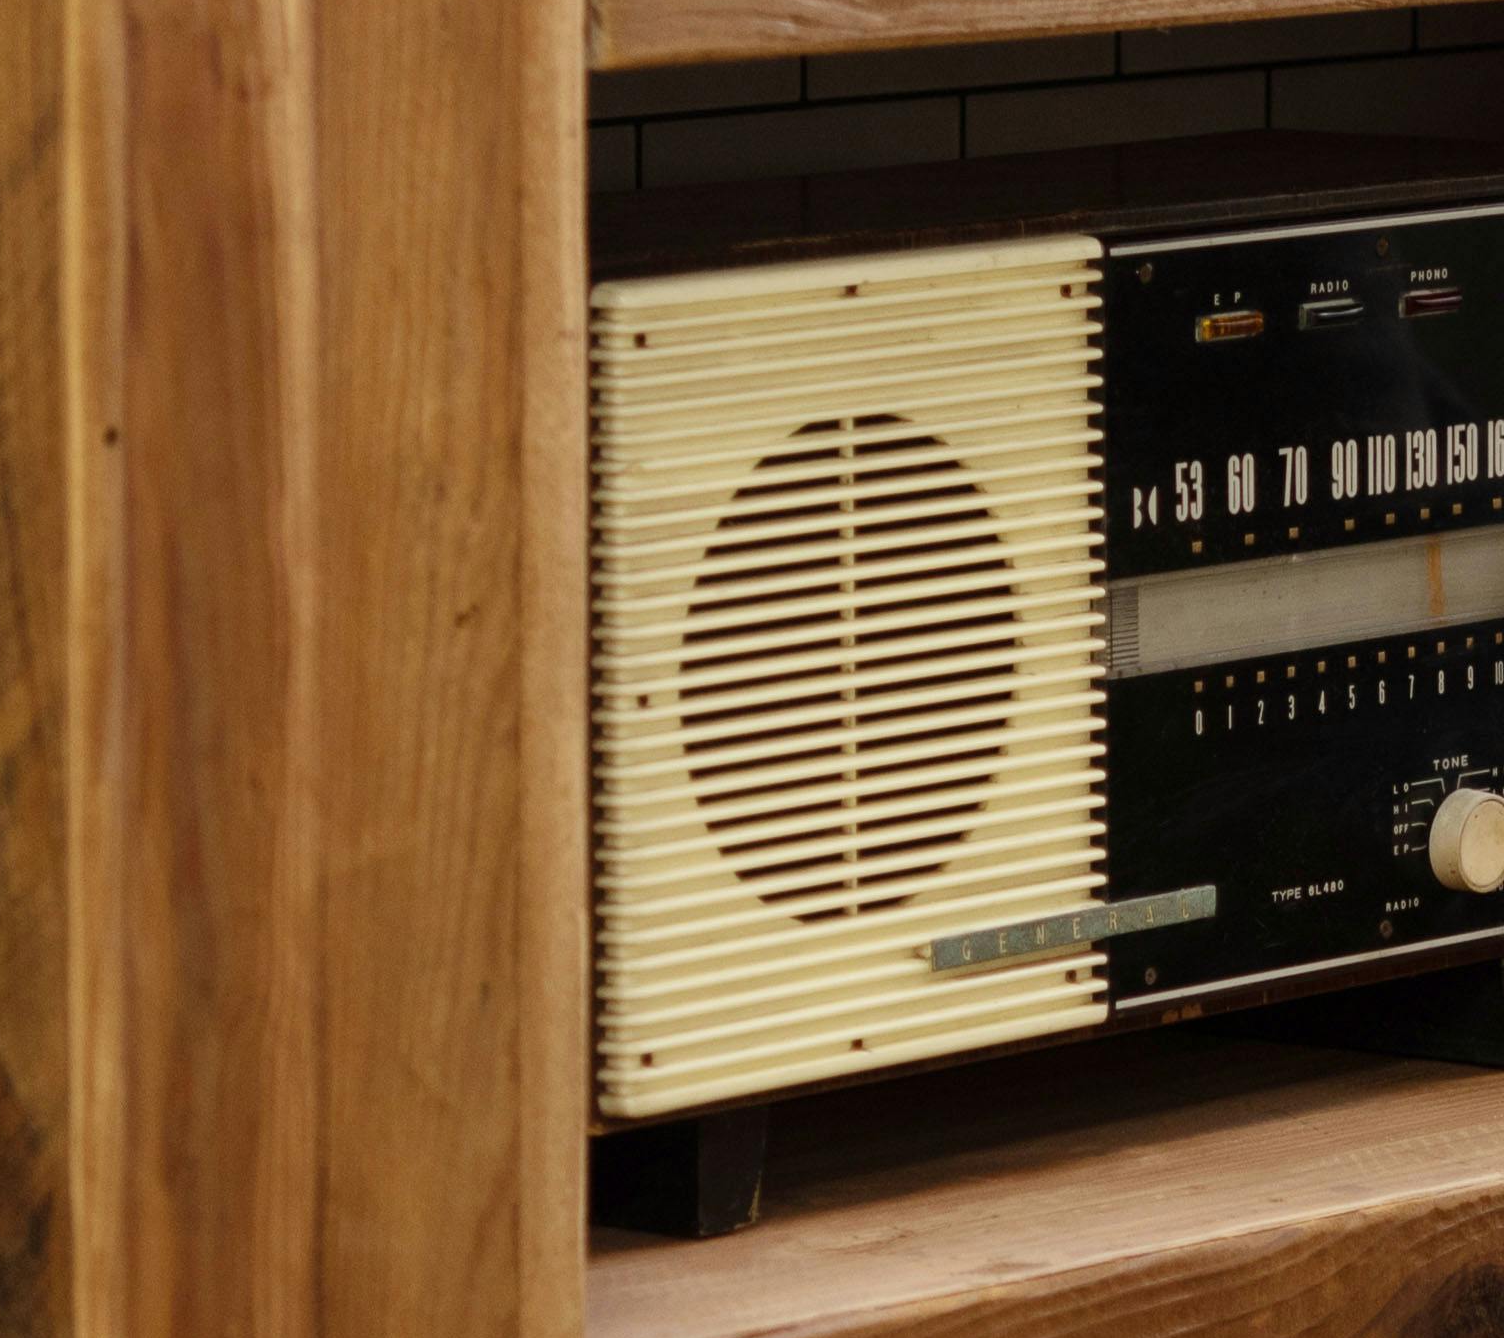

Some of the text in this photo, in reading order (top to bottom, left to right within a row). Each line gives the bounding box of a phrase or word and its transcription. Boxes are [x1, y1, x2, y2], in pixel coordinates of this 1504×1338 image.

[1410, 267, 1449, 282] PHONO
[1310, 279, 1350, 294] RADIO
[1175, 460, 1203, 522] 53
[1227, 452, 1255, 515] 60
[1278, 445, 1308, 508] 70
[1331, 438, 1358, 500] 90
[1367, 434, 1396, 496] 110
[1405, 428, 1438, 491] 130
[1446, 422, 1479, 485] 150
[1195, 709, 1203, 736] 0
[1257, 699, 1265, 725] 2
[1288, 694, 1295, 720] 3
[1318, 690, 1326, 714] 4
[1348, 684, 1356, 710] 5
[1378, 679, 1386, 705] 6
[1408, 674, 1415, 699] 7
[1438, 669, 1445, 695] 8
[1467, 665, 1474, 690] 9
[1494, 660, 1504, 685] 10
[1432, 754, 1469, 771] TONE
[1393, 823, 1409, 835] OFF
[1271, 886, 1302, 902] TYPE
[1385, 897, 1420, 912] RADIO
